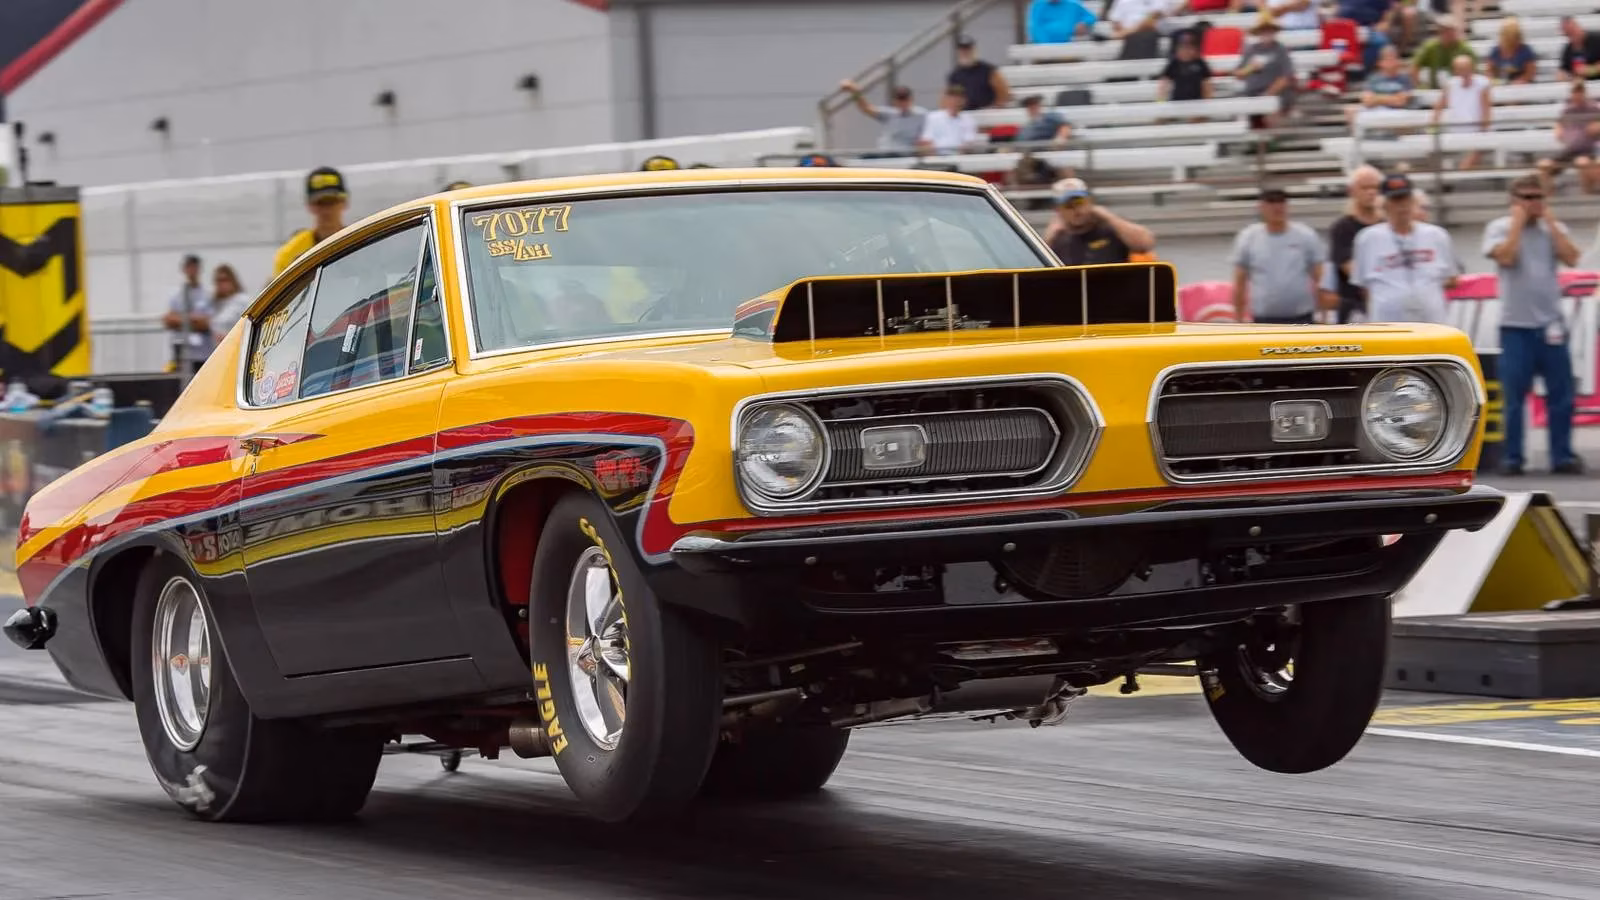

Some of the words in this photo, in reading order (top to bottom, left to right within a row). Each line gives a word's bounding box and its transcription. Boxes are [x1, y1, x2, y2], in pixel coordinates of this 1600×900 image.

[472, 204, 572, 241] 7077
[487, 239, 553, 262] SS/AH
[533, 661, 569, 755] EAGLE
